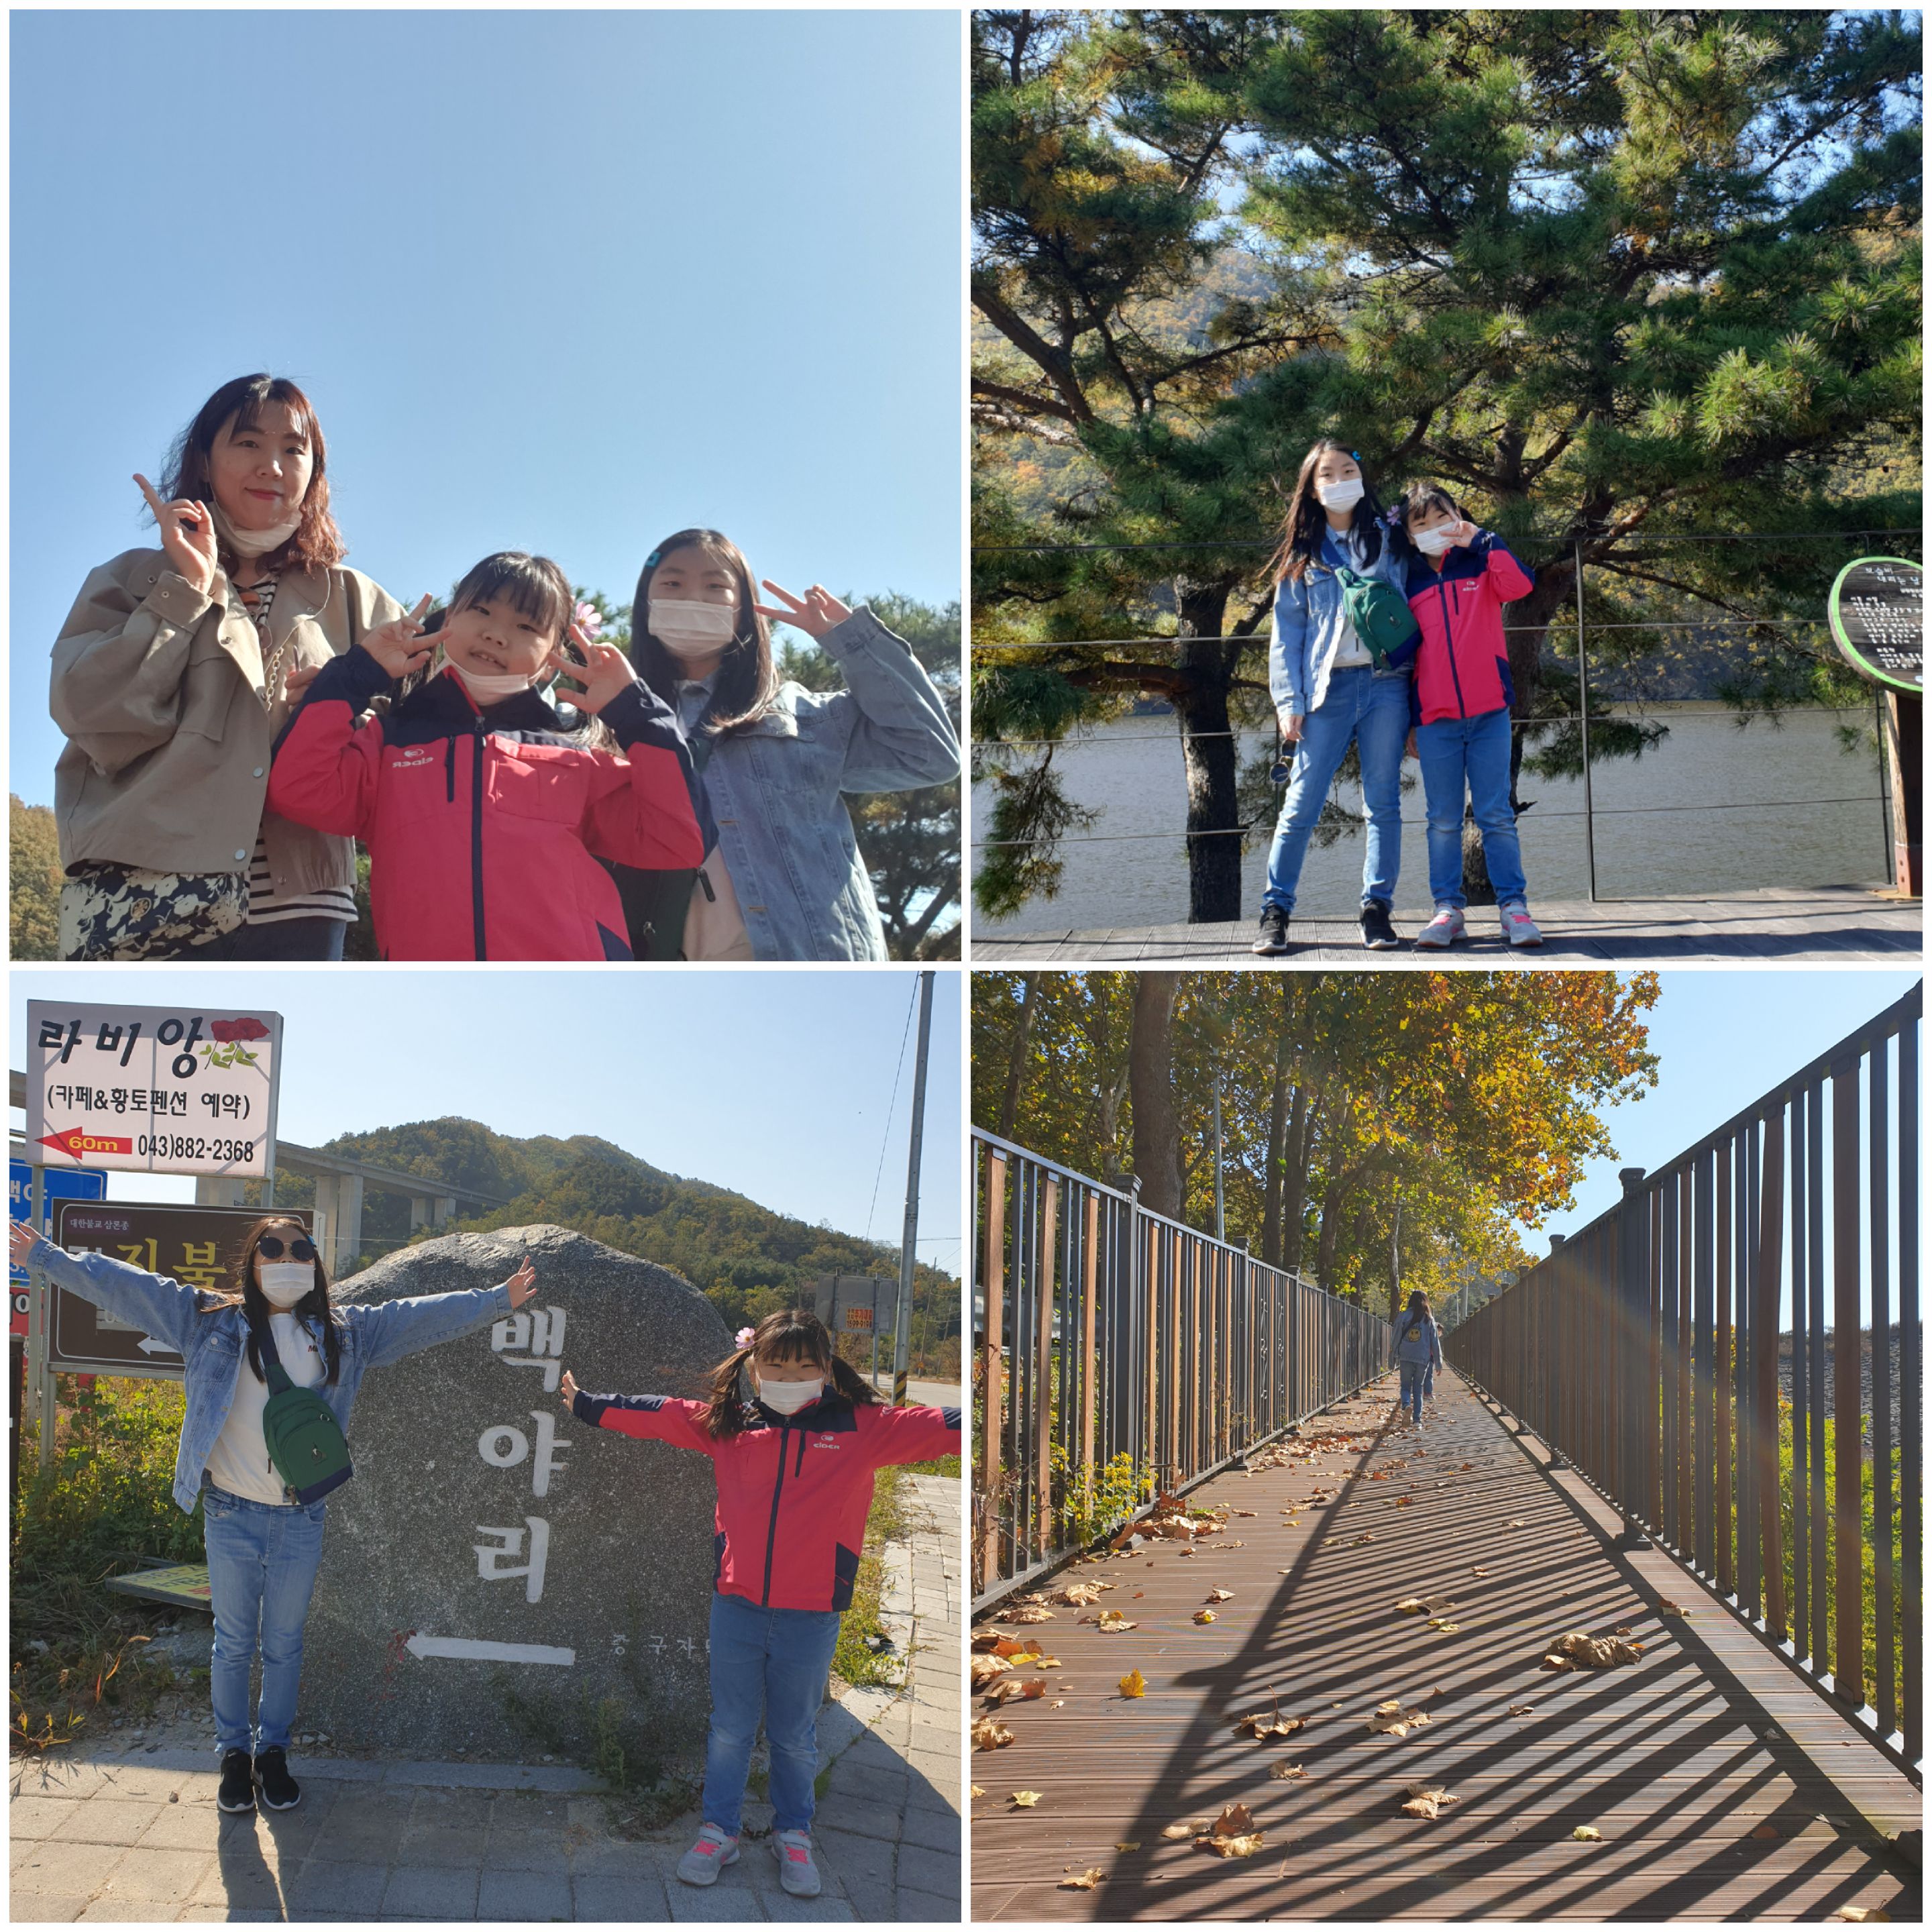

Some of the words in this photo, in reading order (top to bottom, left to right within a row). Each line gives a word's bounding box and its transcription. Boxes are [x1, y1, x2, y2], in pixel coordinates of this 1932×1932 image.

[48, 1085, 187, 1116] (카페&황토펜션
[201, 1092, 250, 1120] 예약)
[68, 1136, 118, 1151] 60m
[138, 1134, 254, 1163] 043)882-2368
[70, 1218, 103, 1228] 대한불교
[473, 1305, 572, 1603] 백야리
